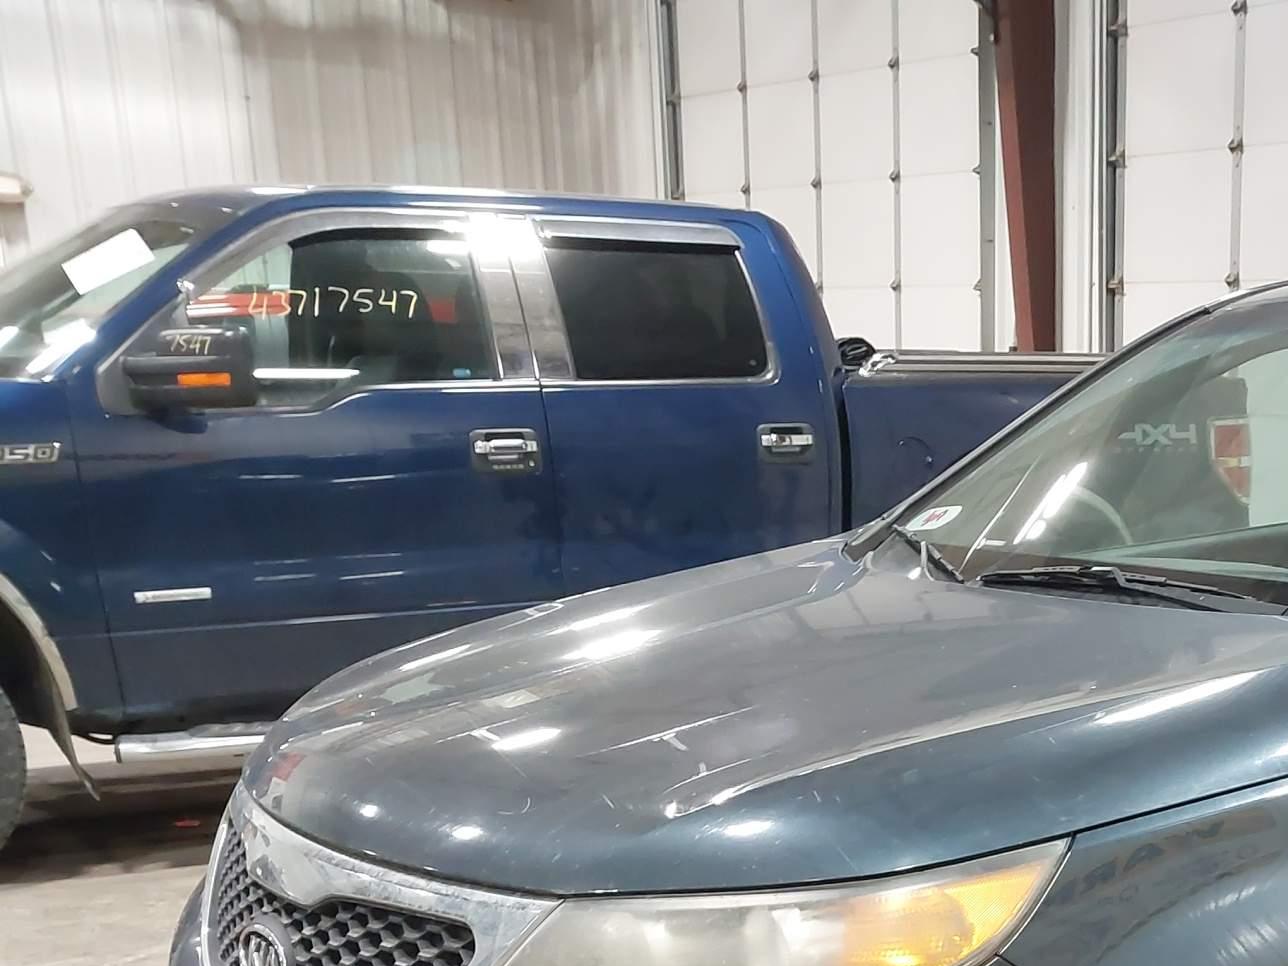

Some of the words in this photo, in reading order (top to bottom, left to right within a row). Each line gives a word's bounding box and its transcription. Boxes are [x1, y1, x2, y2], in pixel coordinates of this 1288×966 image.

[248, 285, 419, 320] 43717547
[166, 334, 212, 355] 7547
[0, 443, 60, 464] 50
